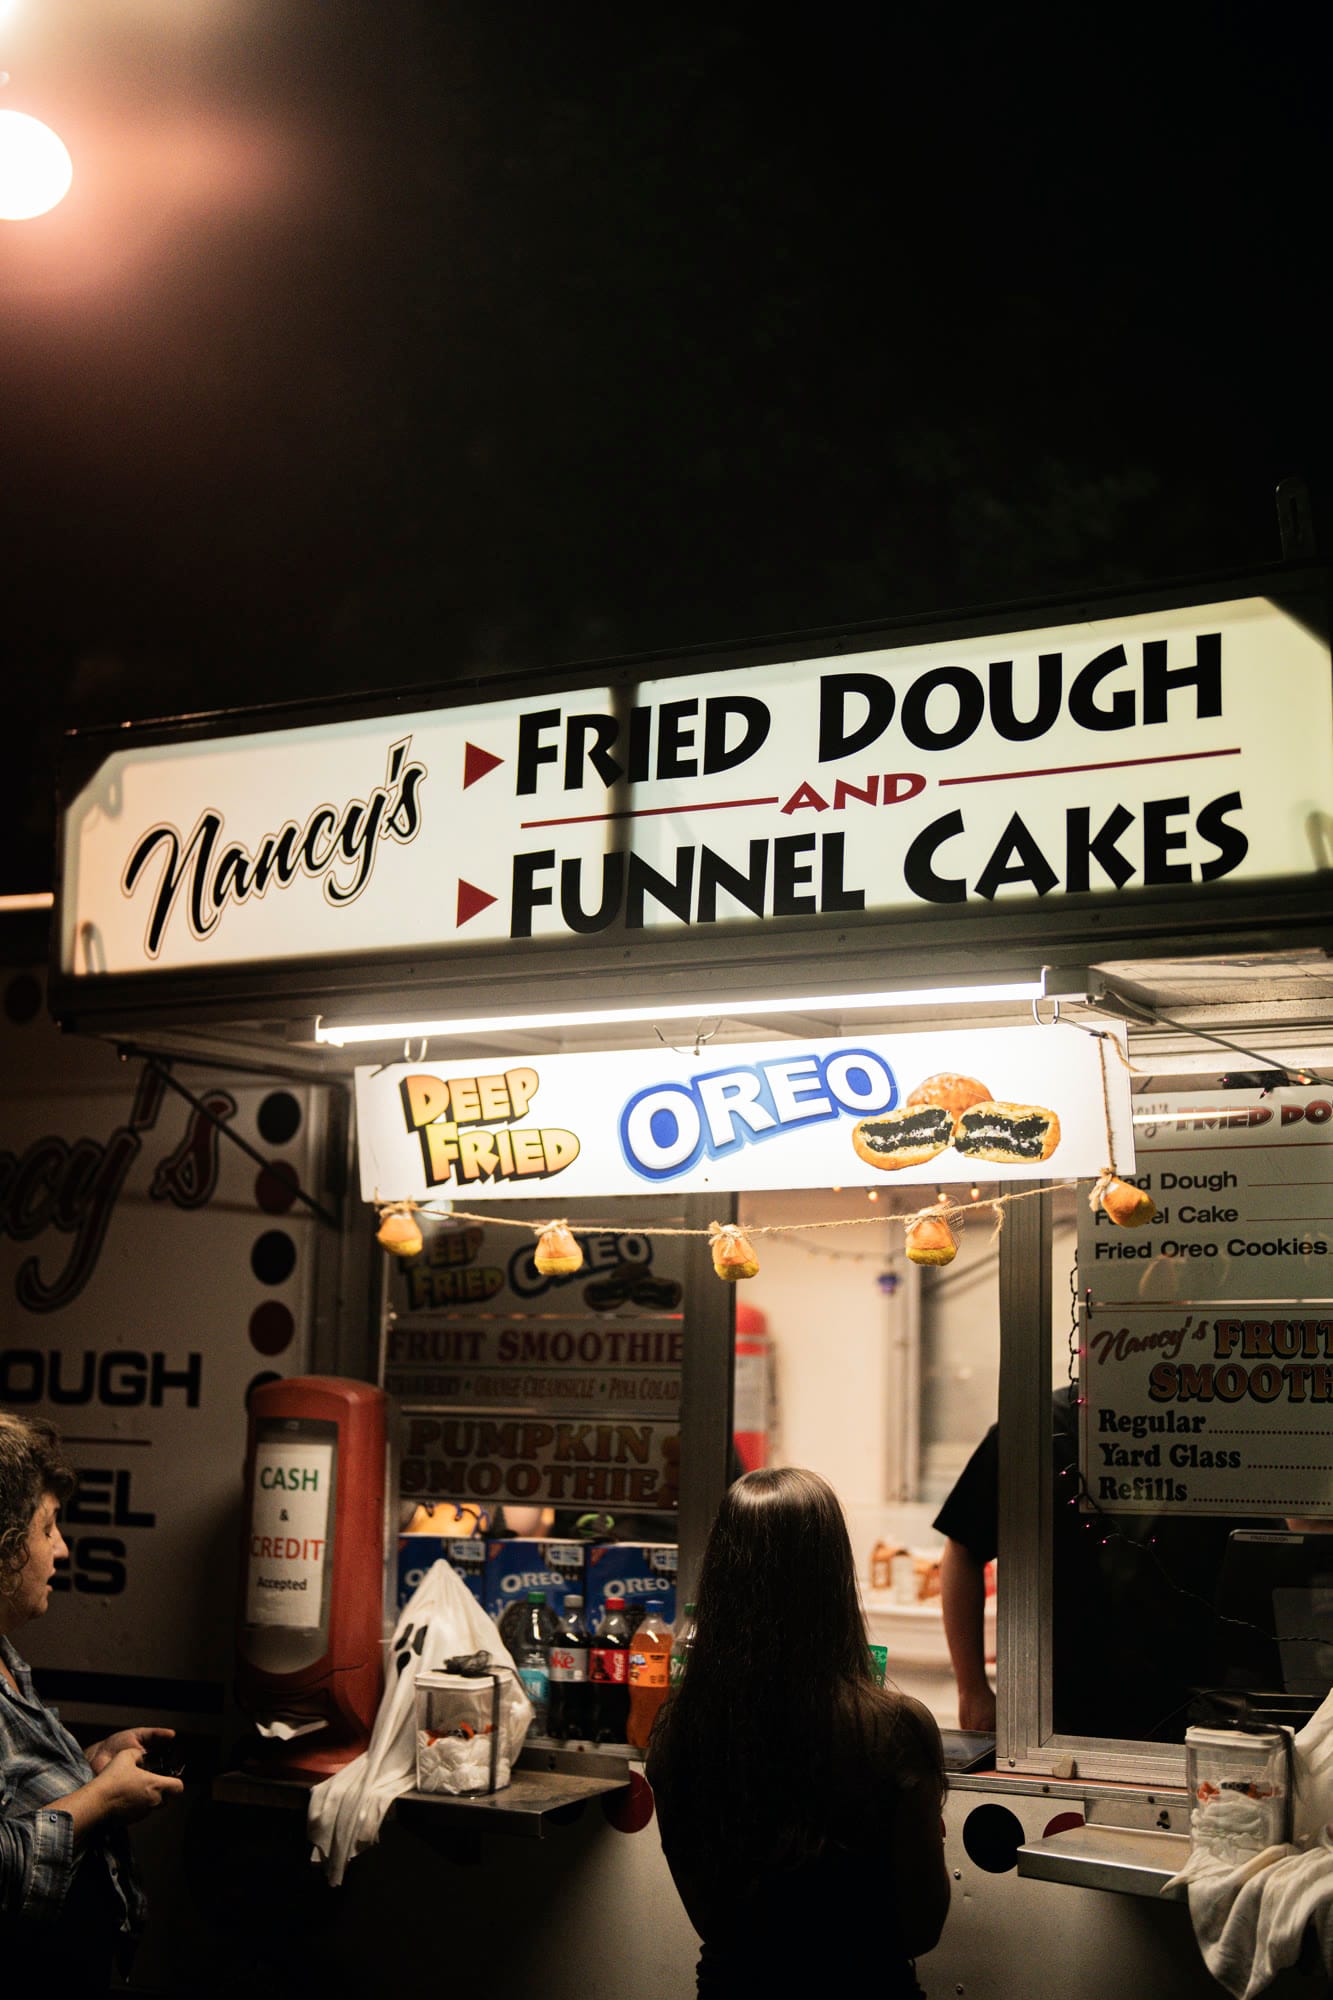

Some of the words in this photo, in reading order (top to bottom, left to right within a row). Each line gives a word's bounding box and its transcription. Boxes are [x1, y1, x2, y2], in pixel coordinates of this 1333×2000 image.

[516, 695, 771, 796] FRIED
[818, 633, 1222, 762] DOUGH
[781, 773, 926, 815] AND
[122, 737, 426, 958] Nancy's
[510, 832, 865, 937] FUNNEL
[904, 791, 1249, 903] CAKES
[400, 1068, 539, 1133] DEEP
[618, 1048, 898, 1183] OREO
[1280, 1099, 1333, 1128] DO
[419, 1122, 580, 1187] FRIED
[1160, 1171, 1237, 1192] Dough
[1178, 1205, 1239, 1223] Cake
[397, 1226, 484, 1273] EEP
[508, 1231, 653, 1298] OEO
[1095, 1241, 1151, 1259] Fried
[1161, 1239, 1218, 1257] Oreo
[1227, 1238, 1327, 1257] Cookies
[405, 1266, 505, 1311] FRIED
[387, 1329, 487, 1361] FRUIT
[497, 1330, 683, 1362] SMOOTHIE
[1090, 1316, 1208, 1365] Nancy's
[1214, 1319, 1333, 1358] FRUIT
[0, 1350, 201, 1407] OUGH
[1150, 1362, 1333, 1402] SMOOTH
[408, 1419, 653, 1464] PUMPKIN
[1099, 1409, 1206, 1438] Regular
[1099, 1443, 1161, 1467] Yard
[1170, 1444, 1241, 1468] Glass
[56, 1467, 154, 1527] EL
[260, 1467, 318, 1491] CASH
[400, 1458, 659, 1501] SMOOTHIE
[1099, 1477, 1187, 1501] Refills
[279, 1509, 288, 1521] &
[249, 1536, 325, 1561] CREDIT
[256, 1576, 307, 1591] Accepted
[501, 1571, 564, 1593] OREO
[603, 1577, 670, 1599] OREO
